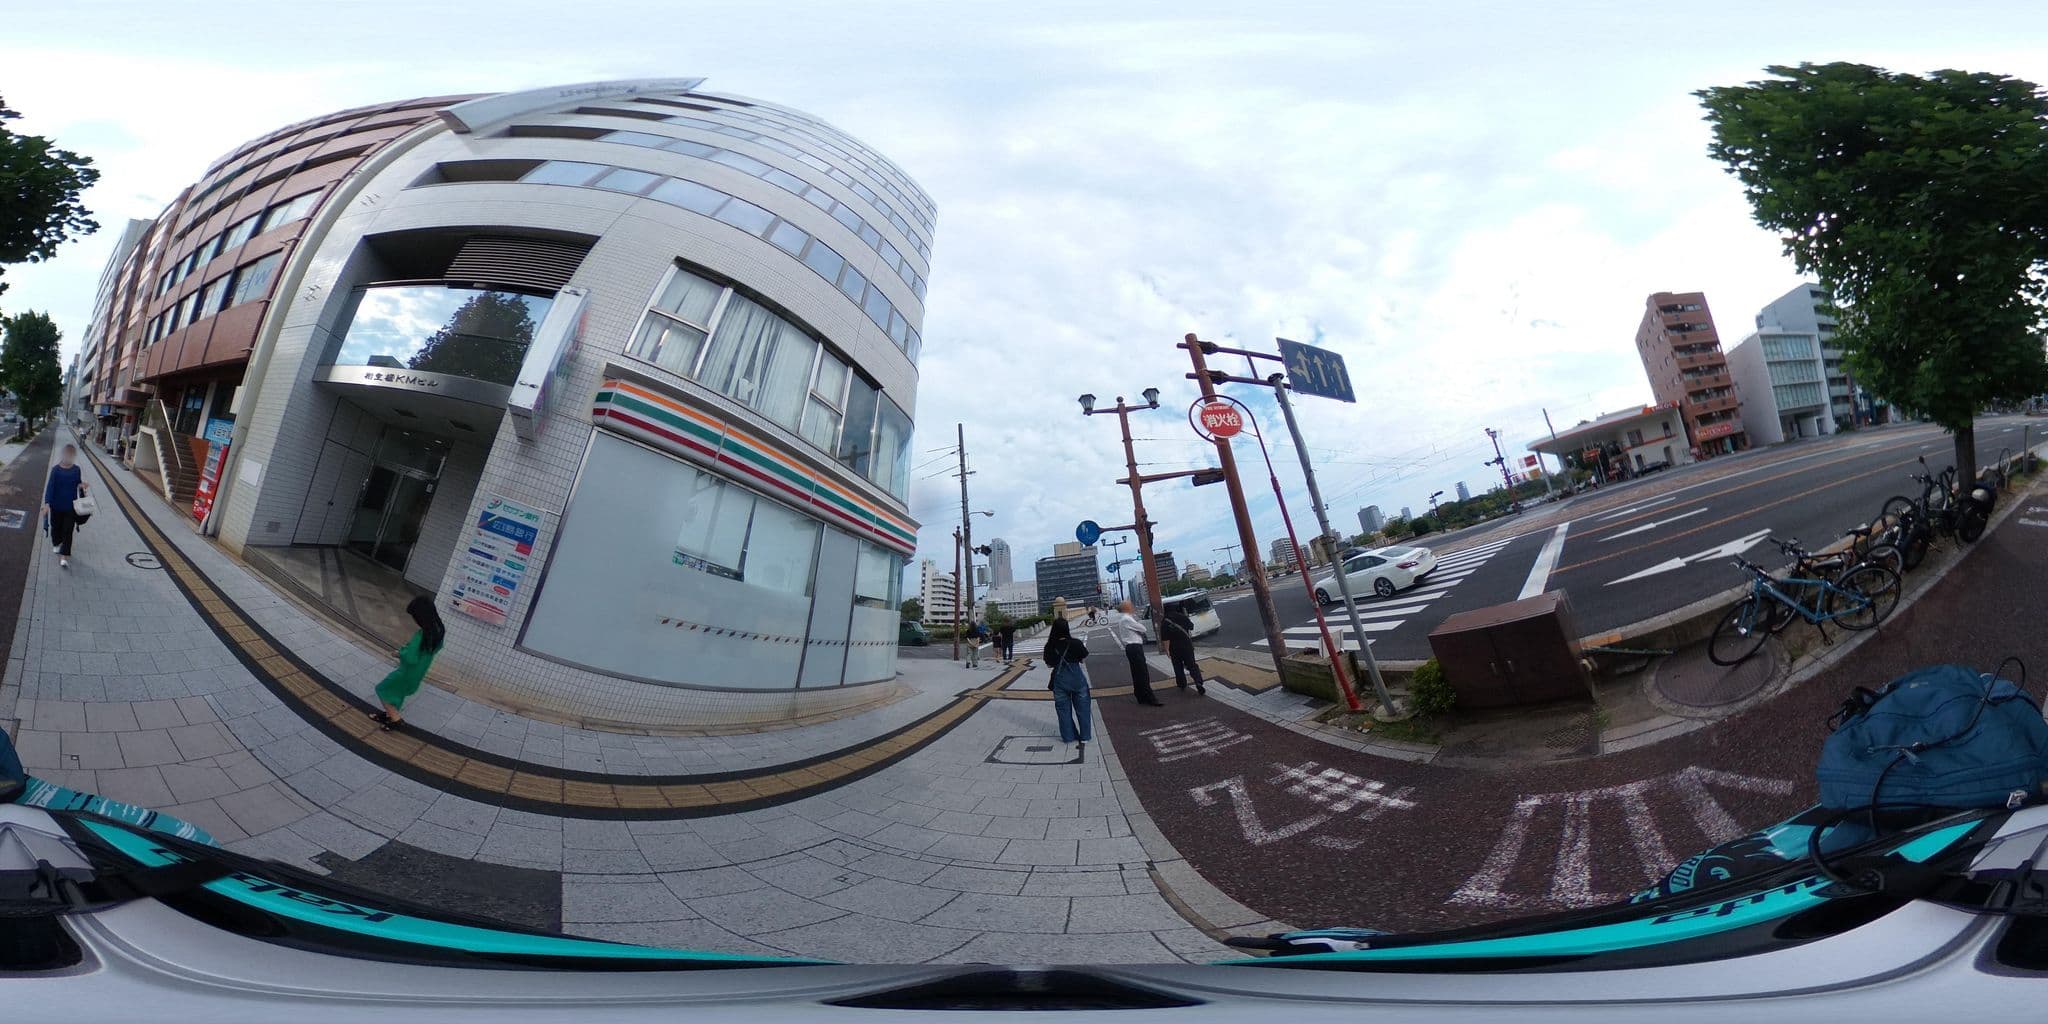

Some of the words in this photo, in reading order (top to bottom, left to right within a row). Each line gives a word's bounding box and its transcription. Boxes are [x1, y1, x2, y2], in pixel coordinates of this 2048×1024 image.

[1202, 412, 1241, 428] 消火栓
[502, 503, 540, 523] セブン銀行
